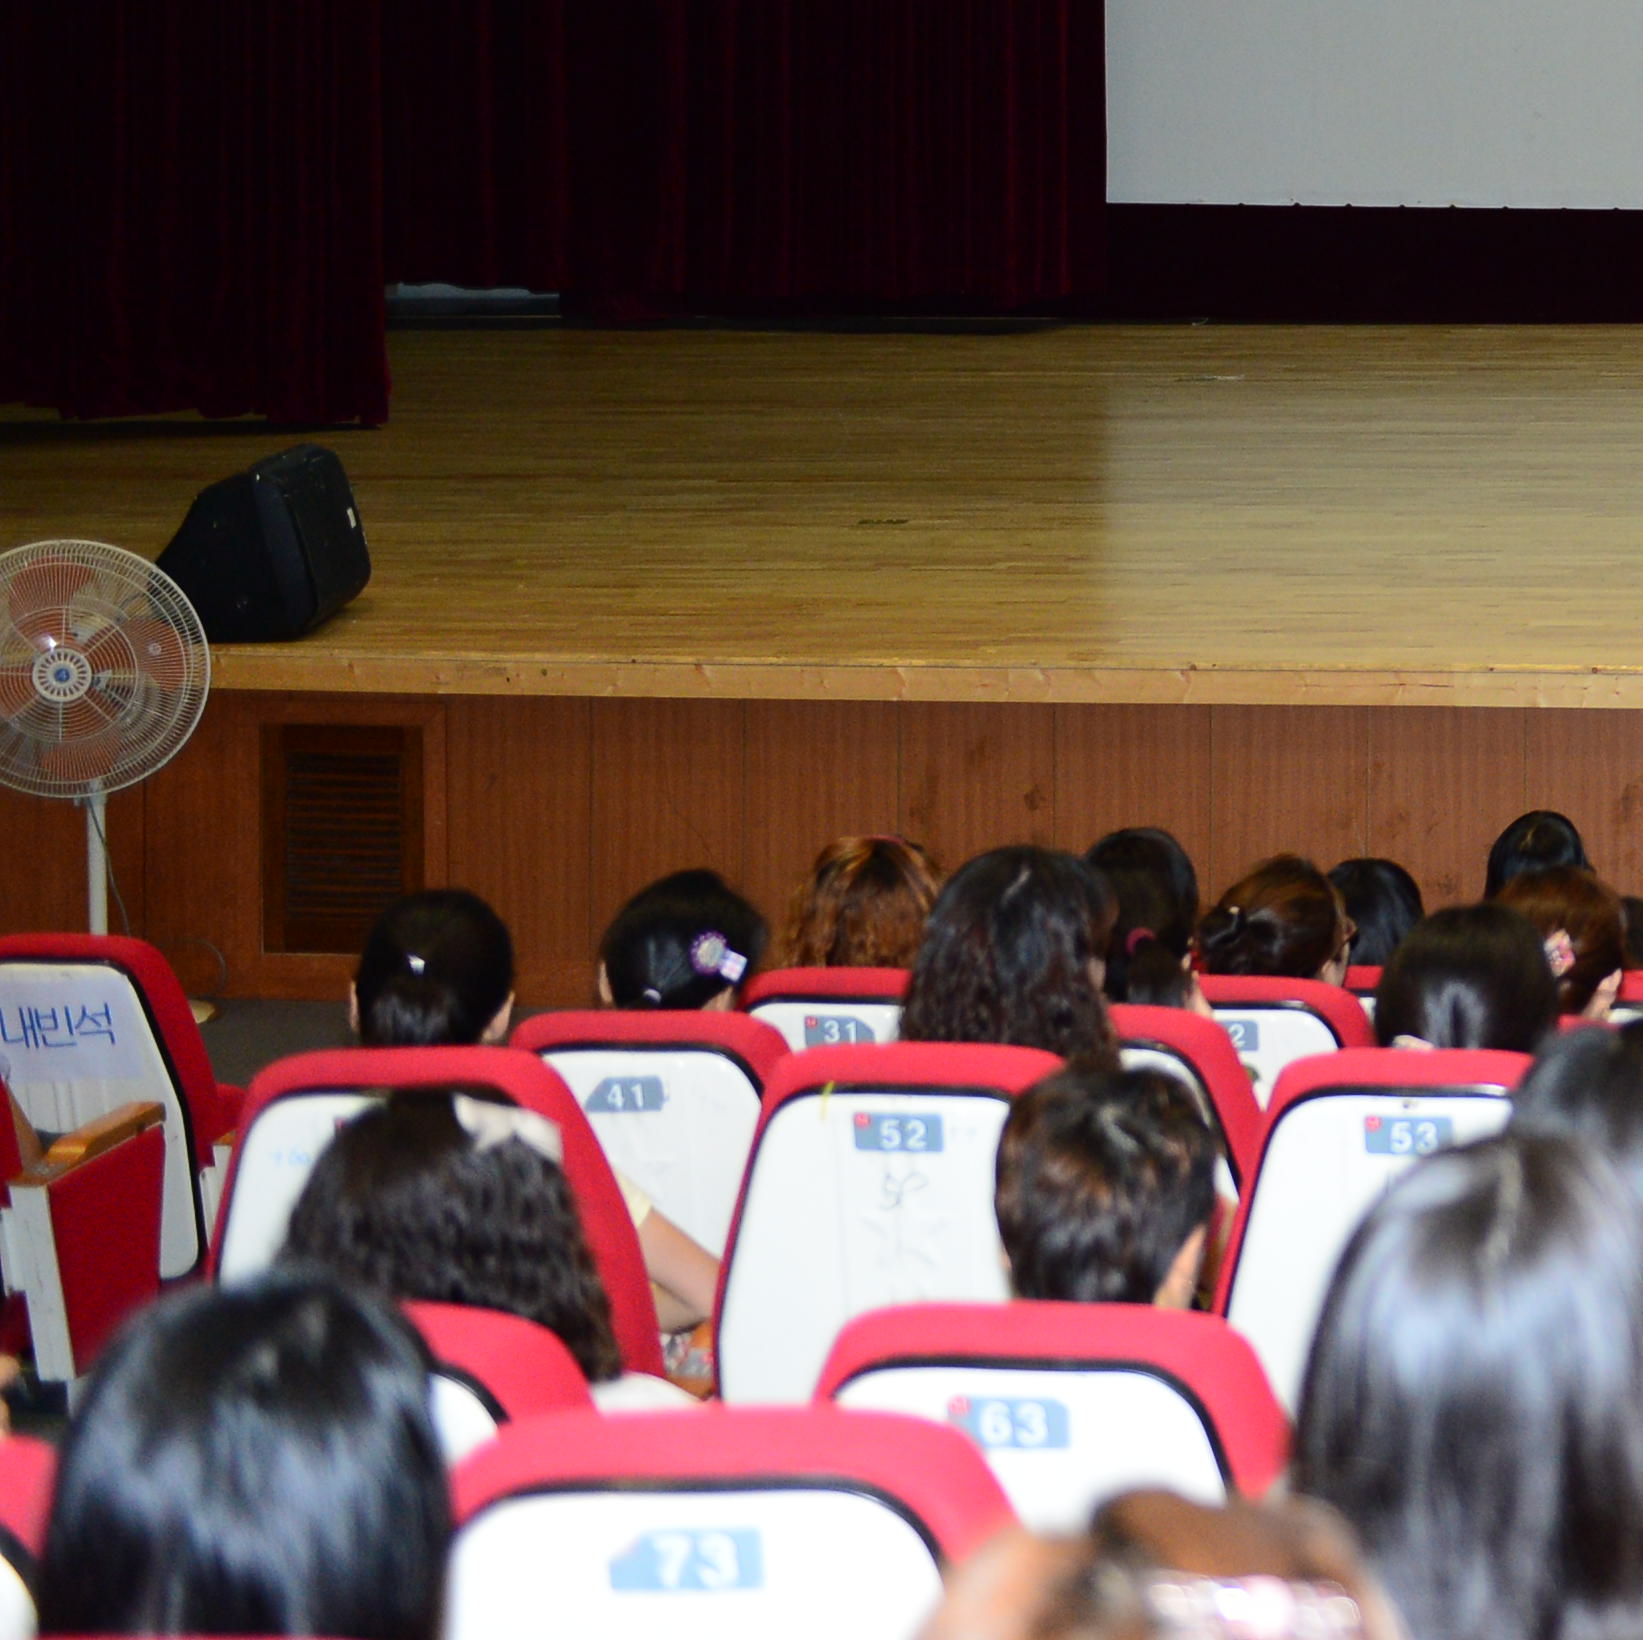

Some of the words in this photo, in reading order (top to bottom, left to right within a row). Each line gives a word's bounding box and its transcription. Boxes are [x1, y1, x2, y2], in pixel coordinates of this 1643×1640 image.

[0, 1003, 116, 1049] 내빈석
[824, 1019, 858, 1044] 31
[607, 1083, 645, 1108] 41
[879, 1119, 927, 1149] 52
[1390, 1120, 1438, 1154] 53
[981, 1401, 1048, 1446] 63
